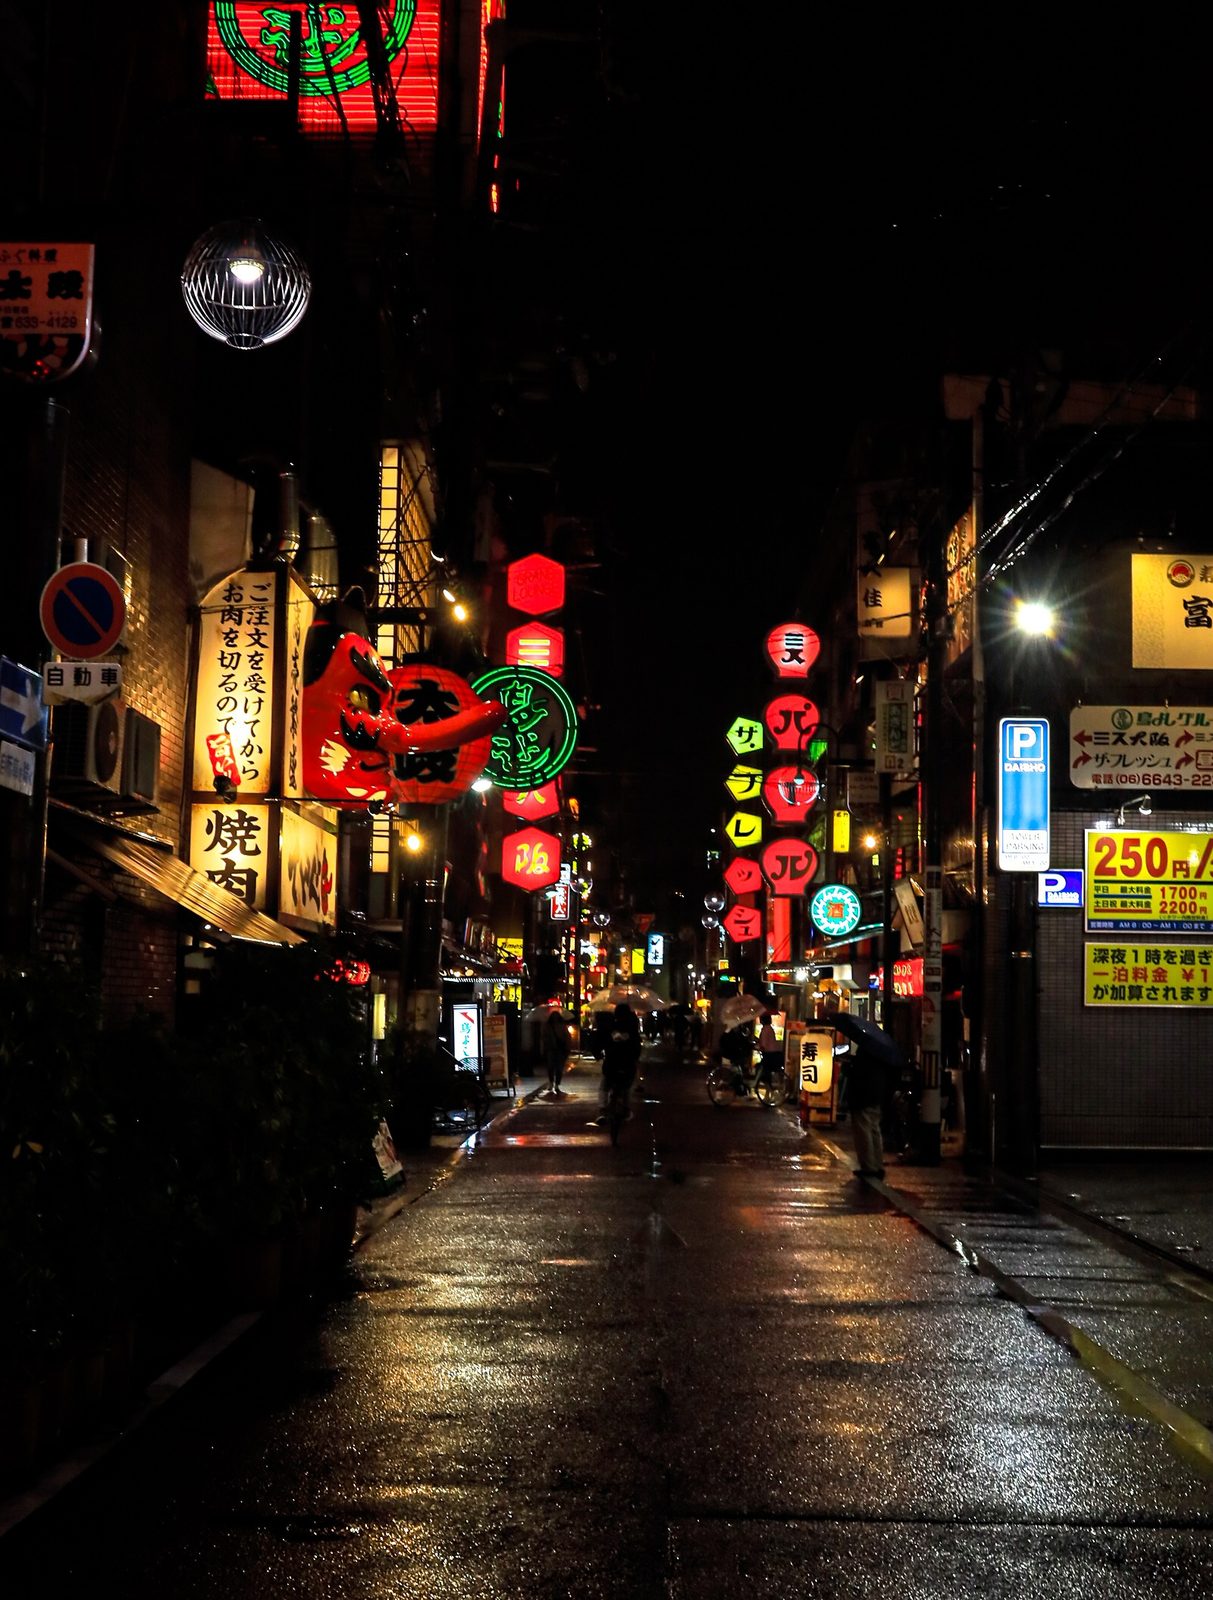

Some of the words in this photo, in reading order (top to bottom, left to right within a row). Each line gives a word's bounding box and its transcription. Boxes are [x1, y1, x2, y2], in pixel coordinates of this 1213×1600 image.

[216, 584, 244, 732] お肉を切るので
[47, 667, 117, 686] 自動車
[240, 583, 270, 781] ご注文を受けてから
[1013, 727, 1036, 757] P
[204, 809, 261, 906] 焼肉
[1038, 873, 1066, 903] P
[1094, 886, 1109, 894] 平日
[1094, 900, 1117, 908] 土日祝
[1093, 948, 1213, 965] 深夜1時を過ぎ
[1093, 967, 1168, 983] 一泊料金
[1093, 984, 1212, 1002] が加算されます
[801, 1042, 818, 1084] 寿司
